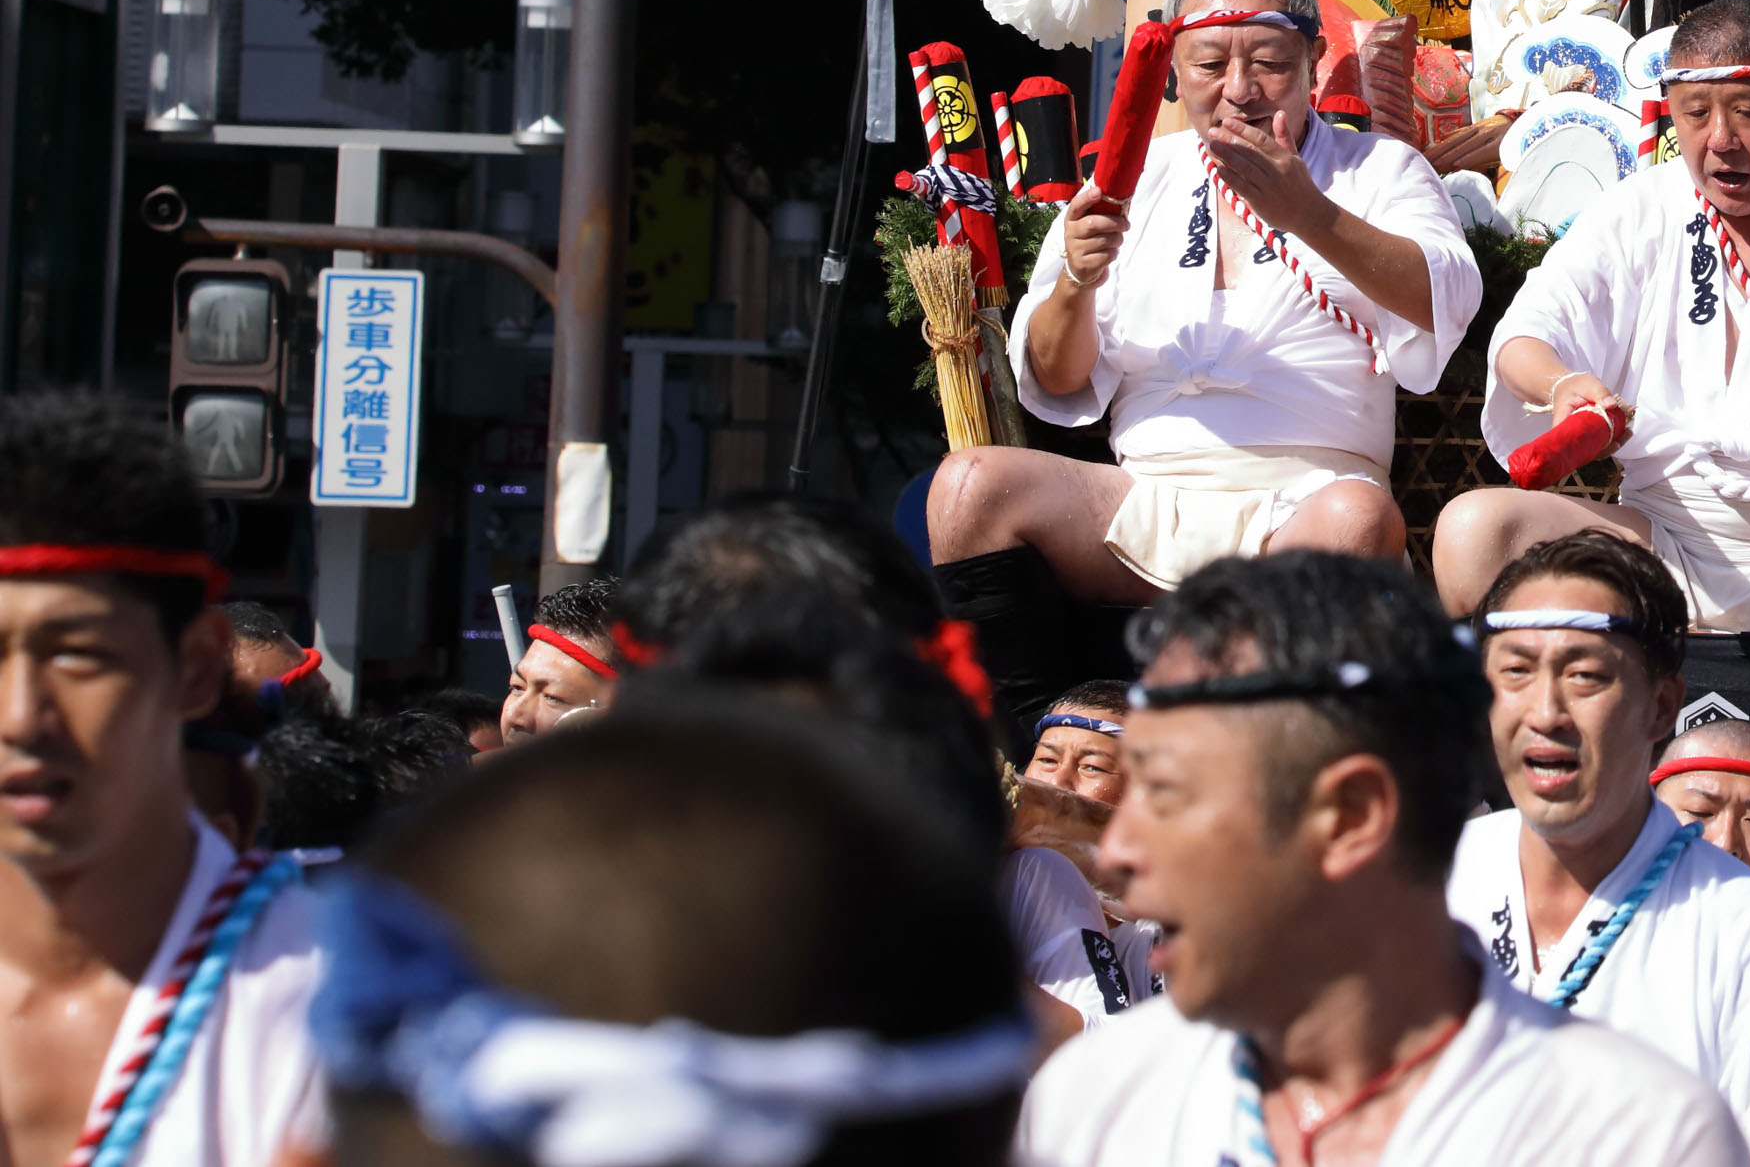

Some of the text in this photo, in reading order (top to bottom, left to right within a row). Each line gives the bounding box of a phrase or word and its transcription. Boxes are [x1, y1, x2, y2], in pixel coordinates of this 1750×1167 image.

[339, 287, 396, 488] 歩車分離信号
